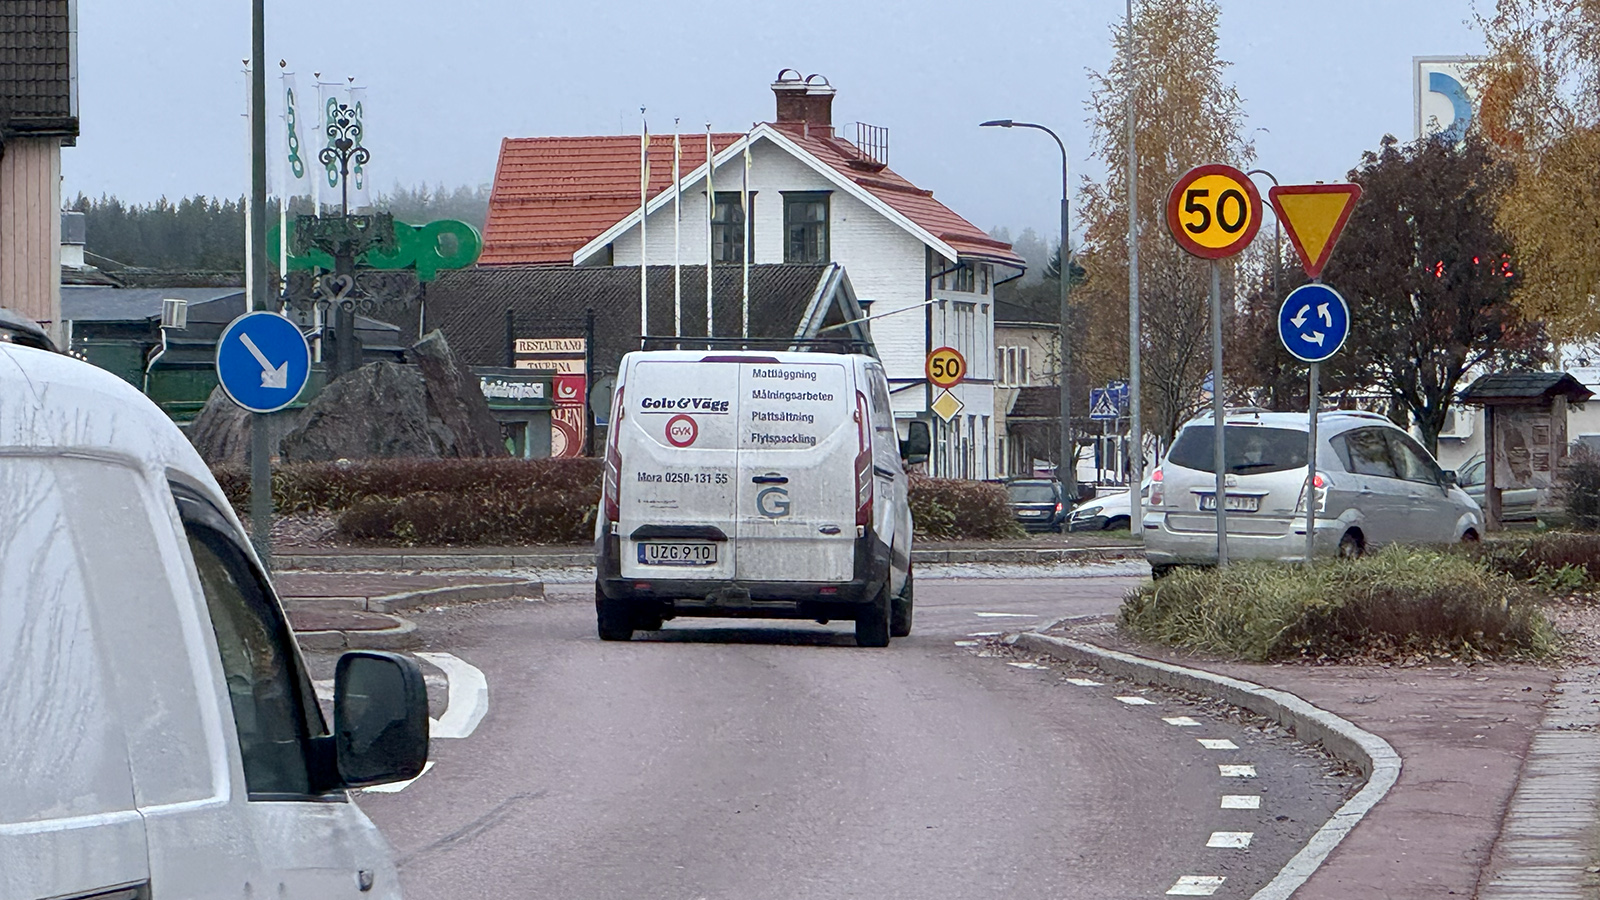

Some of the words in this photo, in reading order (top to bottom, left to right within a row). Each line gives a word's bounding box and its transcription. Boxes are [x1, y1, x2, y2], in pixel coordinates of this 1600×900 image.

[1185, 189, 1247, 234] 50
[932, 358, 960, 378] 50
[752, 369, 817, 381] Mattläggning
[752, 389, 834, 402] Målningsarbeten
[751, 411, 815, 424] Plattsättning
[671, 426, 692, 436] GVK
[751, 432, 817, 446] Flytspackling
[637, 472, 662, 483] Mora
[665, 472, 711, 484] 0250-131
[715, 473, 728, 485] 55
[756, 486, 790, 519] G
[650, 546, 679, 560] UZG
[682, 546, 711, 560] 910
